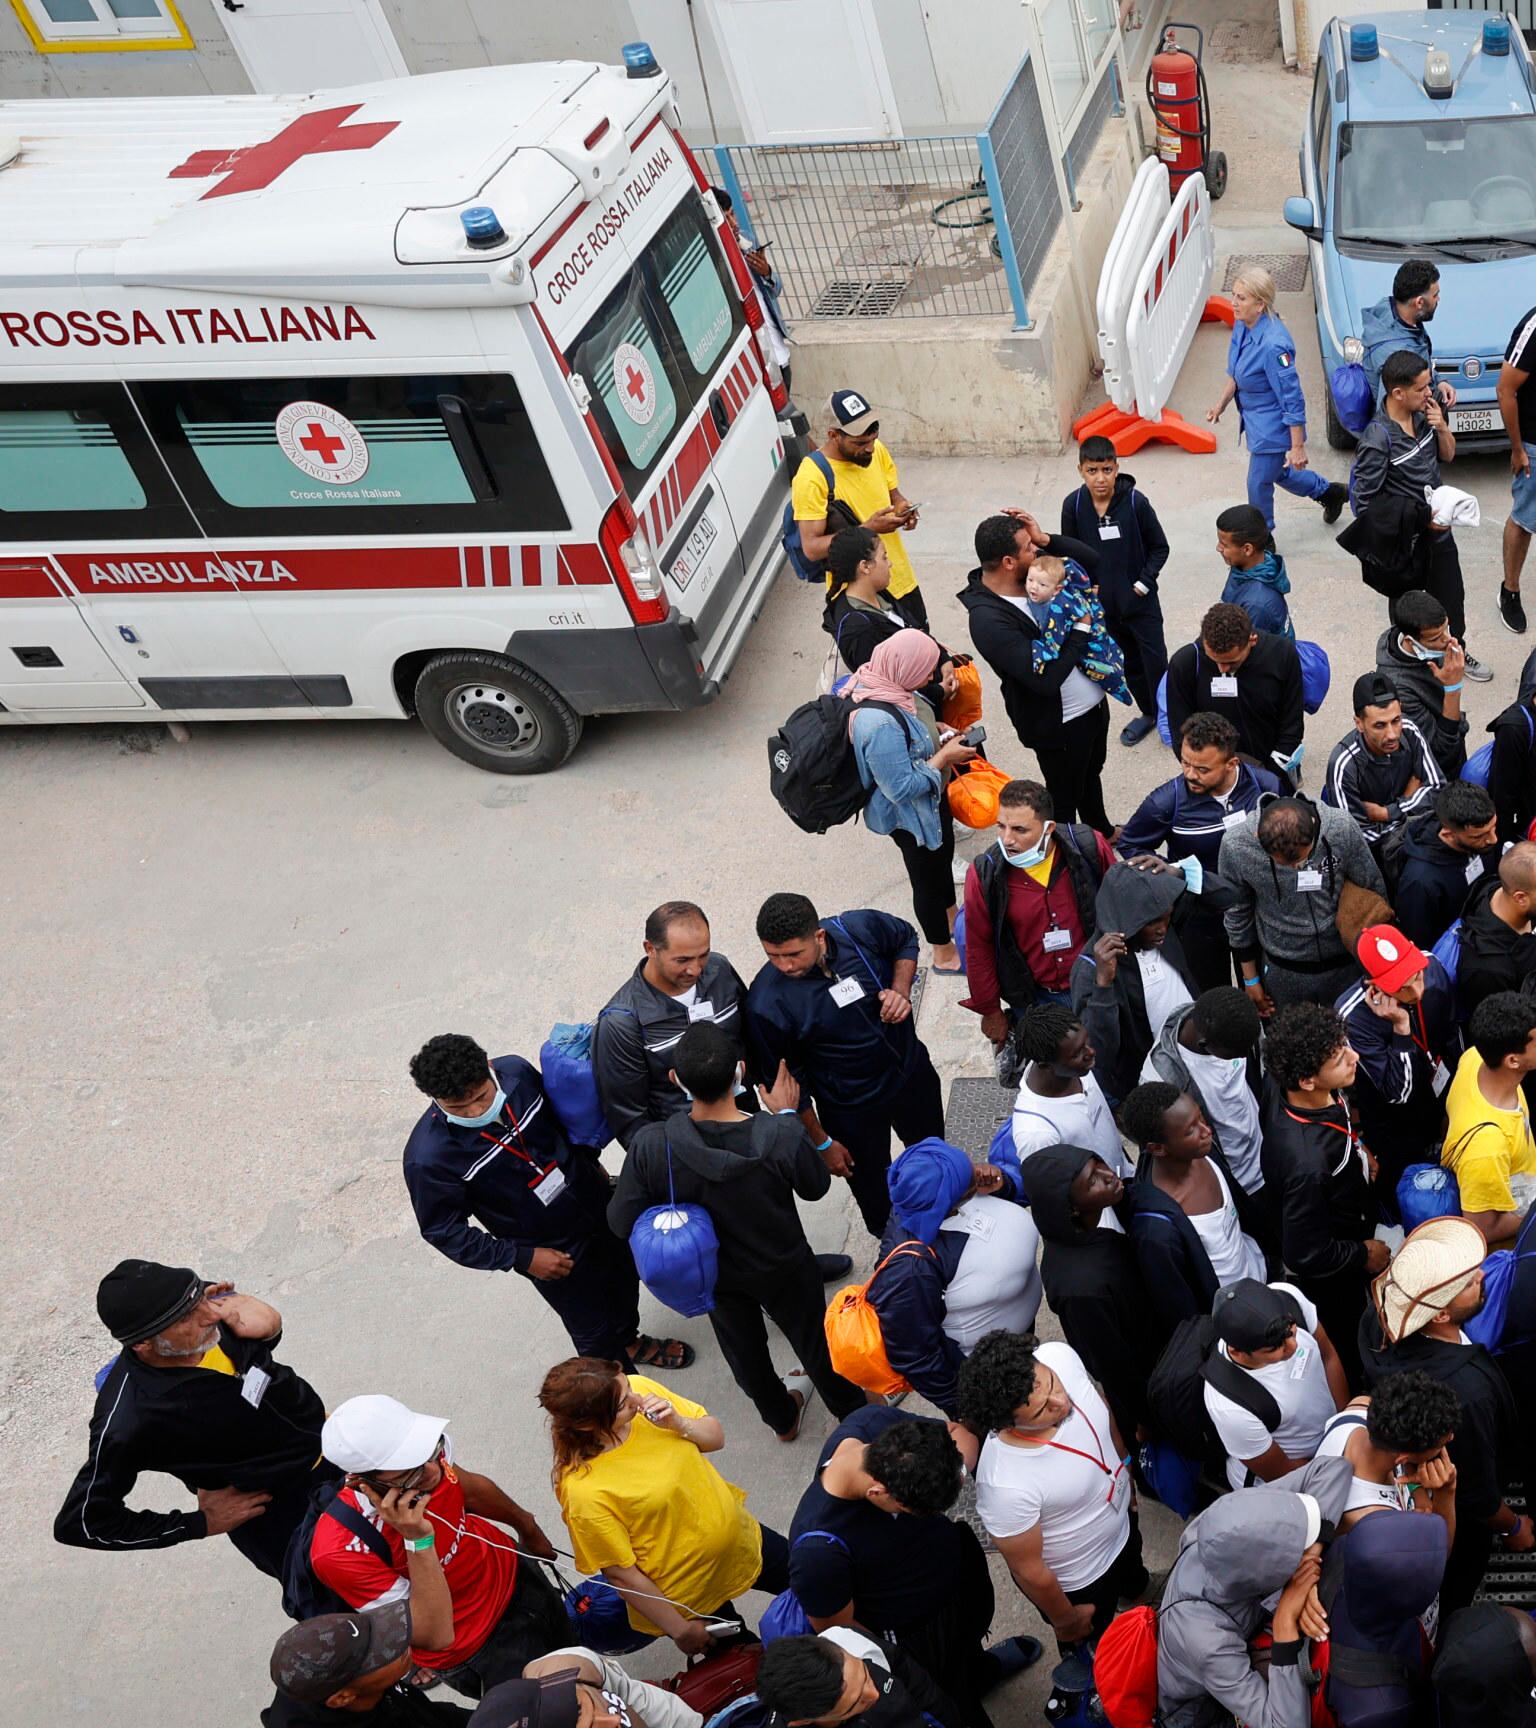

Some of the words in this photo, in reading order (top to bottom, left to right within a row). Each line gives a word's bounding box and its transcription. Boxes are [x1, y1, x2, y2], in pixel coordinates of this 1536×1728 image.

[547, 243, 594, 305] CROCE
[586, 199, 631, 257] ROSSA
[623, 146, 673, 213] ITALIANA
[0, 310, 166, 347] ROSSA
[165, 305, 377, 345] ITALIANA
[1456, 411, 1492, 420] POLIZIA
[1457, 419, 1492, 432] H3023
[289, 489, 323, 500] Croce
[325, 489, 361, 499] Rossa
[360, 488, 402, 499] Italiana
[700, 517, 714, 541] AD
[88, 559, 298, 585] AMBULANZA
[548, 611, 585, 626] cri.it
